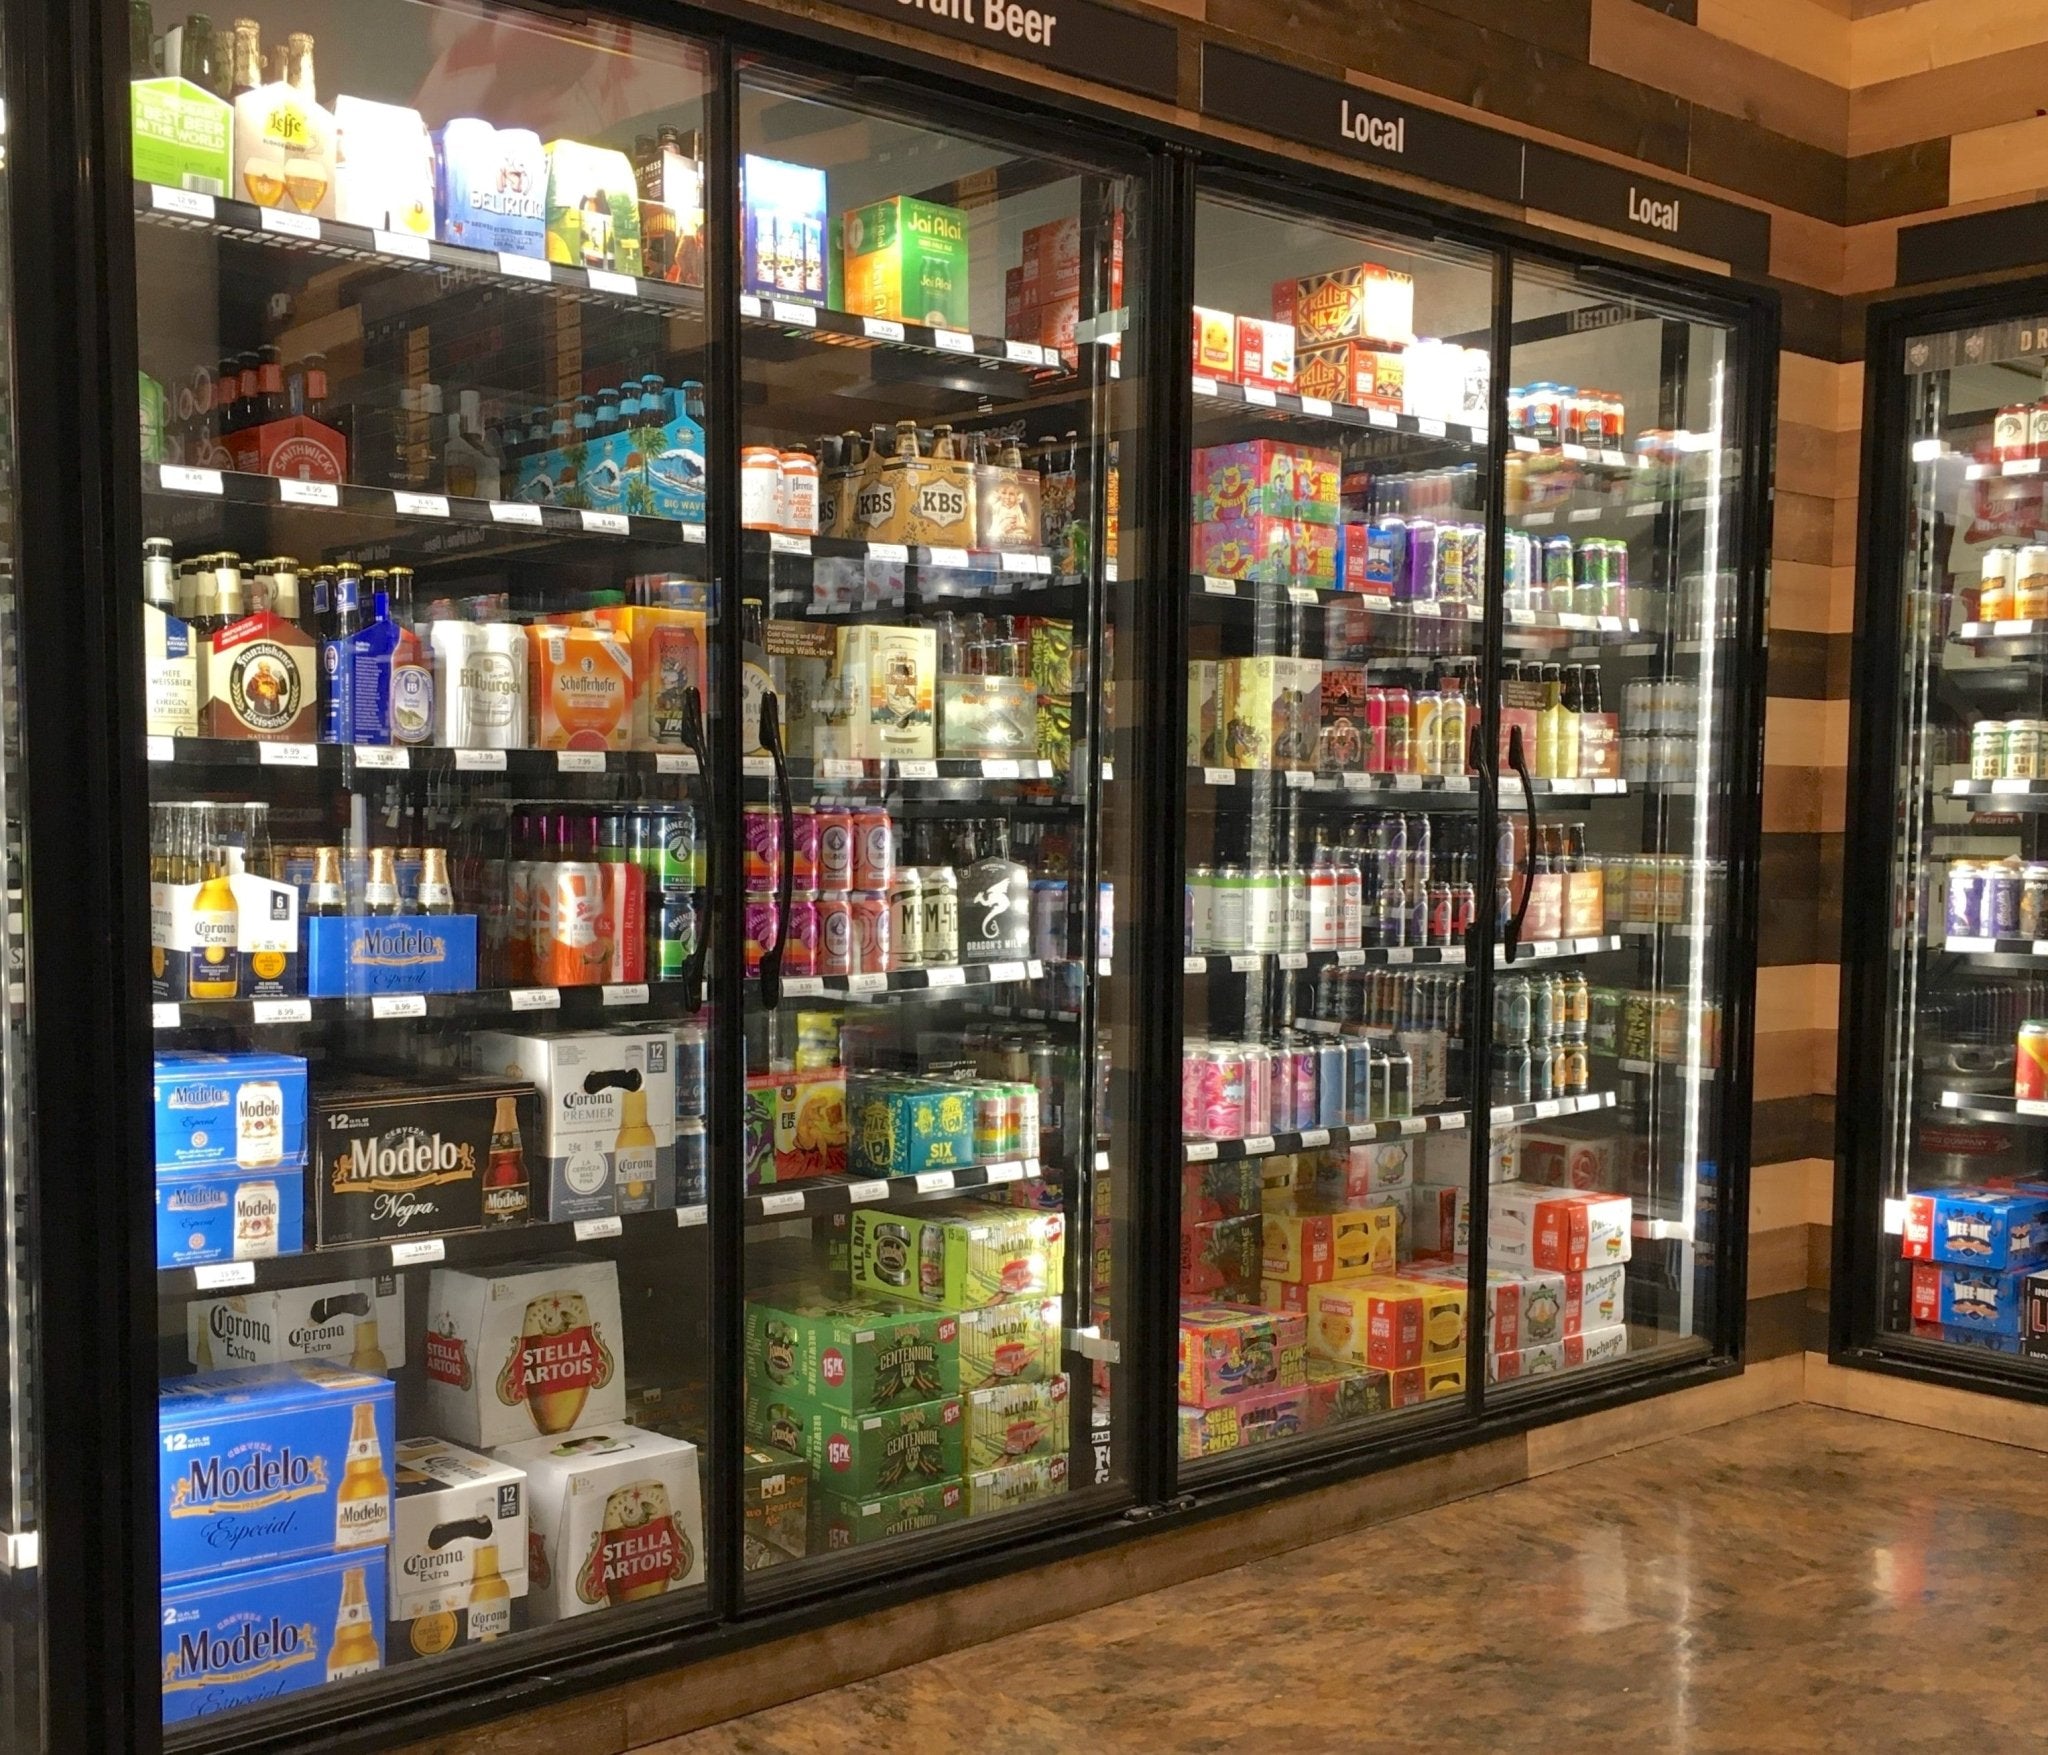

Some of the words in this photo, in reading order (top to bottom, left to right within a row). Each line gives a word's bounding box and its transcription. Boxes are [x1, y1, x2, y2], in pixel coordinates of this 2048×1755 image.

[984, 0, 1057, 47] Beer
[184, 115, 224, 136] BEER
[1341, 100, 1404, 153] Local
[178, 126, 224, 148] WORLD
[1629, 187, 1679, 232] Local
[908, 212, 931, 233] Jai
[934, 217, 962, 240] Alai
[1310, 286, 1348, 307] KELLER
[1300, 361, 1335, 384] KELLER
[860, 492, 892, 515] KBS
[923, 491, 963, 514] KBS
[767, 644, 795, 655] Please
[152, 677, 192, 688] WEISSBIER
[162, 669, 181, 679] HEFE
[560, 676, 616, 693] Schöfferhofer
[153, 706, 168, 715] OF
[168, 705, 192, 716] BEER
[156, 697, 189, 708] ORIGIN
[174, 725, 184, 737] 6
[477, 752, 494, 761] 7.99
[276, 895, 284, 909] 6
[194, 920, 236, 936] Corona
[204, 934, 228, 944] Extra
[364, 927, 434, 955] Modelo
[277, 1007, 294, 1016] 8.99
[650, 1043, 664, 1059] 12
[175, 1086, 223, 1104] Modelo
[563, 1091, 614, 1109] Corona
[239, 1100, 280, 1118] Modelo
[563, 1107, 615, 1121] PREMIER
[328, 1114, 349, 1130] 12
[384, 1126, 425, 1140] CERVEZA
[352, 1134, 458, 1180] Modelo
[930, 1143, 953, 1157] SIX
[618, 1157, 654, 1173] Corona
[175, 1188, 222, 1205] Modelo
[486, 1192, 525, 1208] Modelo
[237, 1200, 277, 1217] Modelo
[853, 1214, 867, 1248] DAY
[1908, 1225, 1929, 1235] SUN
[853, 1250, 867, 1282] ALL
[1585, 1269, 1622, 1296] Pachanga
[1916, 1286, 1935, 1296] SUN
[1916, 1295, 1935, 1305] KING
[210, 1303, 271, 1344] Corona
[991, 1325, 1009, 1339] ALL
[1010, 1321, 1029, 1335] DAY
[288, 1325, 345, 1348] Corona
[222, 1337, 256, 1362] Extra
[301, 1341, 332, 1355] Extra
[427, 1341, 462, 1363] STELLA
[522, 1339, 592, 1367] STELLA
[1586, 1333, 1623, 1360] Pachanga
[426, 1357, 462, 1377] ARTOIS
[823, 1357, 845, 1379] 15PK
[880, 1345, 935, 1372] CENTENNIAL
[521, 1358, 593, 1387] ARTOIS
[901, 1361, 916, 1377] IPA
[942, 1404, 961, 1424] 15PK
[1003, 1402, 1021, 1418] ALL
[1021, 1399, 1039, 1414] DAY
[163, 1433, 188, 1453] 12
[228, 1442, 272, 1459] CERVEZA
[887, 1429, 940, 1458] CENTENNIAL
[828, 1442, 851, 1465] 15PK
[189, 1446, 310, 1503] Modelo
[425, 1456, 488, 1480] Corona
[1051, 1461, 1067, 1481] 15PK
[502, 1486, 516, 1503] 12
[1004, 1484, 1021, 1500] ALL
[1022, 1481, 1039, 1497] DAY
[343, 1505, 385, 1523] Modelo
[765, 1497, 804, 1516] Hearted
[602, 1530, 672, 1561] STELLA
[403, 1550, 464, 1577] Corona
[601, 1549, 673, 1582] ARTOIS
[420, 1569, 450, 1583] Extra
[217, 1612, 262, 1630] CERVEZA
[471, 1609, 508, 1627] Corona
[179, 1616, 299, 1678] Modelo
